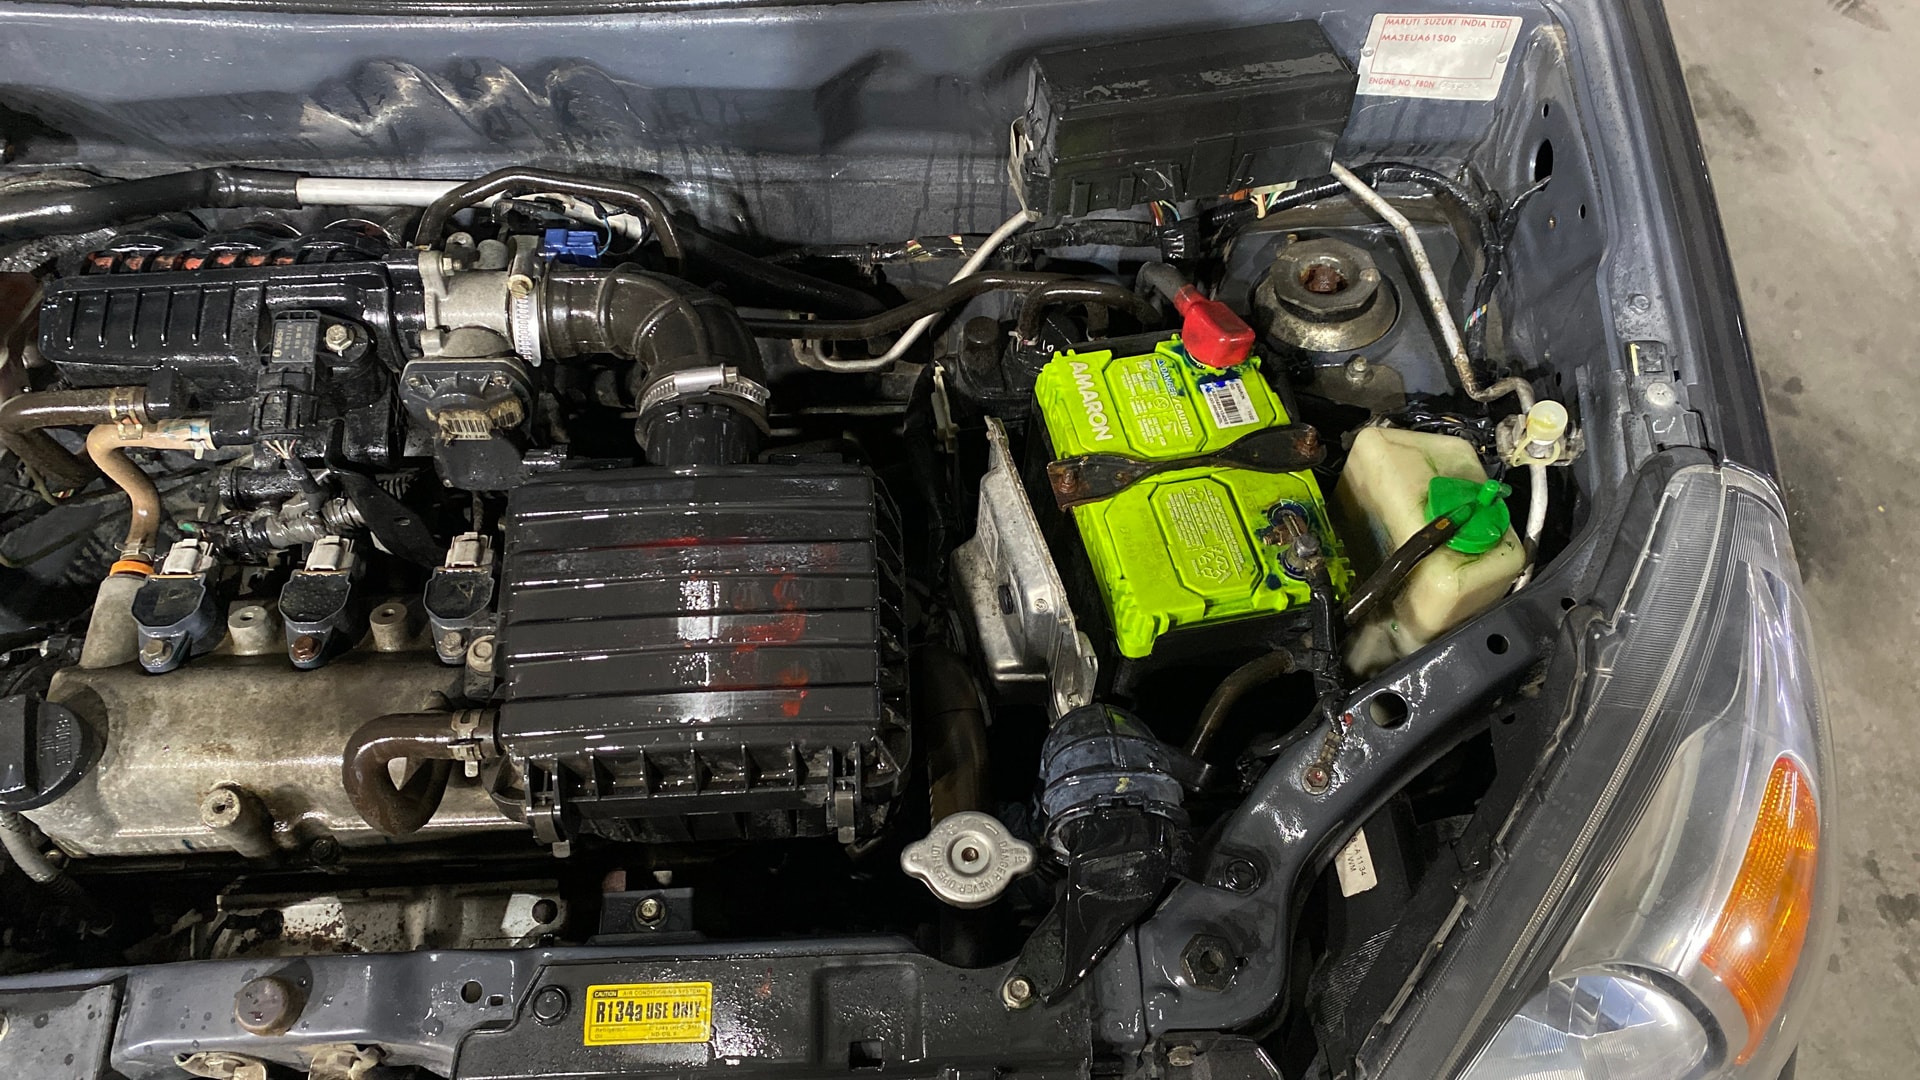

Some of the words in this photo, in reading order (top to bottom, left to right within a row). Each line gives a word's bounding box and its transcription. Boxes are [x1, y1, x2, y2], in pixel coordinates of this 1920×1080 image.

[1386, 18, 1420, 26] MARUTI
[1424, 18, 1457, 26] SUZUKI
[1461, 19, 1487, 28] INDIA
[1368, 77, 1395, 86] ENGINE
[1069, 361, 1113, 441] AMARON
[1161, 367, 1178, 397] DANGER
[1175, 403, 1194, 438] CAUTION
[992, 840, 1009, 881] DANGER
[959, 879, 993, 893] NEVER
[596, 1000, 643, 1023] R134a
[646, 1002, 669, 1020] USE
[672, 1000, 702, 1019] ONLY
